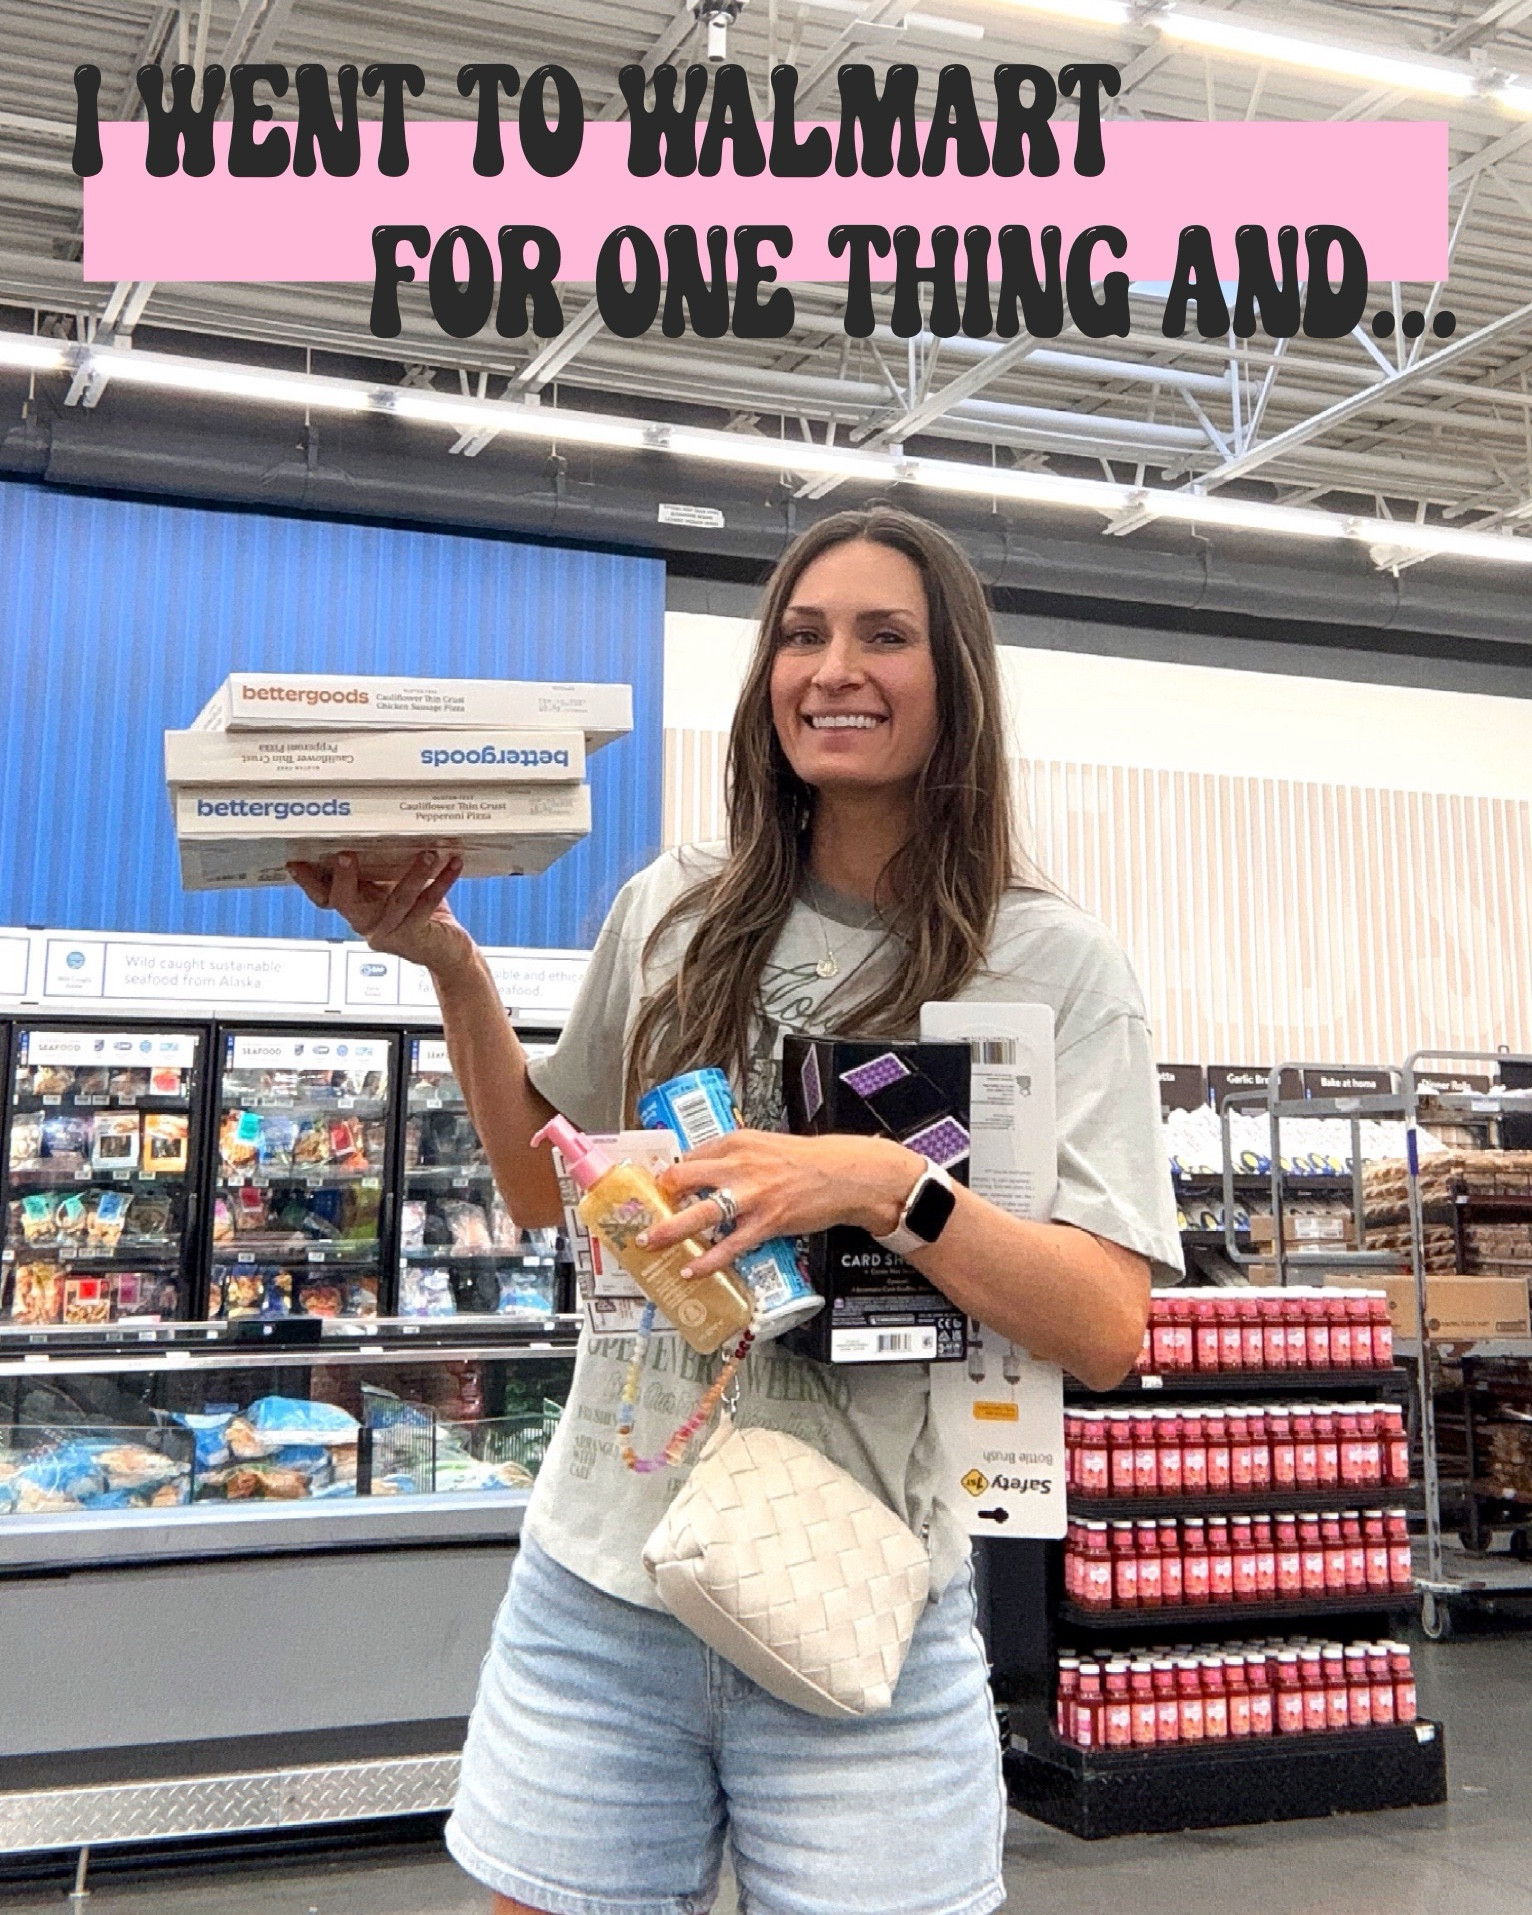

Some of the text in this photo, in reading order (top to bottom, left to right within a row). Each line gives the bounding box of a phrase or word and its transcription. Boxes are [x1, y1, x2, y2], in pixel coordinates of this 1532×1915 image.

[242, 685, 370, 706] bettergoods
[375, 692, 465, 704] Cauliflower Thin Crust
[376, 701, 409, 710] Chicken
[444, 704, 466, 712] Pizza
[258, 742, 339, 753] Pepperoni Pizza
[241, 755, 355, 764] Cauliflower Thin Crust
[420, 745, 569, 767] bettergoods
[197, 799, 351, 819] bettergoods
[399, 802, 507, 811] Cauliflower Thin Crust
[415, 812, 492, 822] Pepperoni Pizza
[125, 955, 282, 975] Wild caught sustainable
[124, 973, 180, 986] seafood
[183, 973, 218, 987] from
[526, 970, 546, 982] and
[38, 1043, 81, 1052] SEAFOOD
[242, 1047, 282, 1056] SEAFOOD
[1226, 1072, 1254, 1085] Garlic
[1320, 1075, 1377, 1089] Bake at home
[840, 1253, 907, 1267] CARD SH
[982, 1450, 1054, 1466] Bottle Brush
[990, 1474, 1053, 1495] Safety
